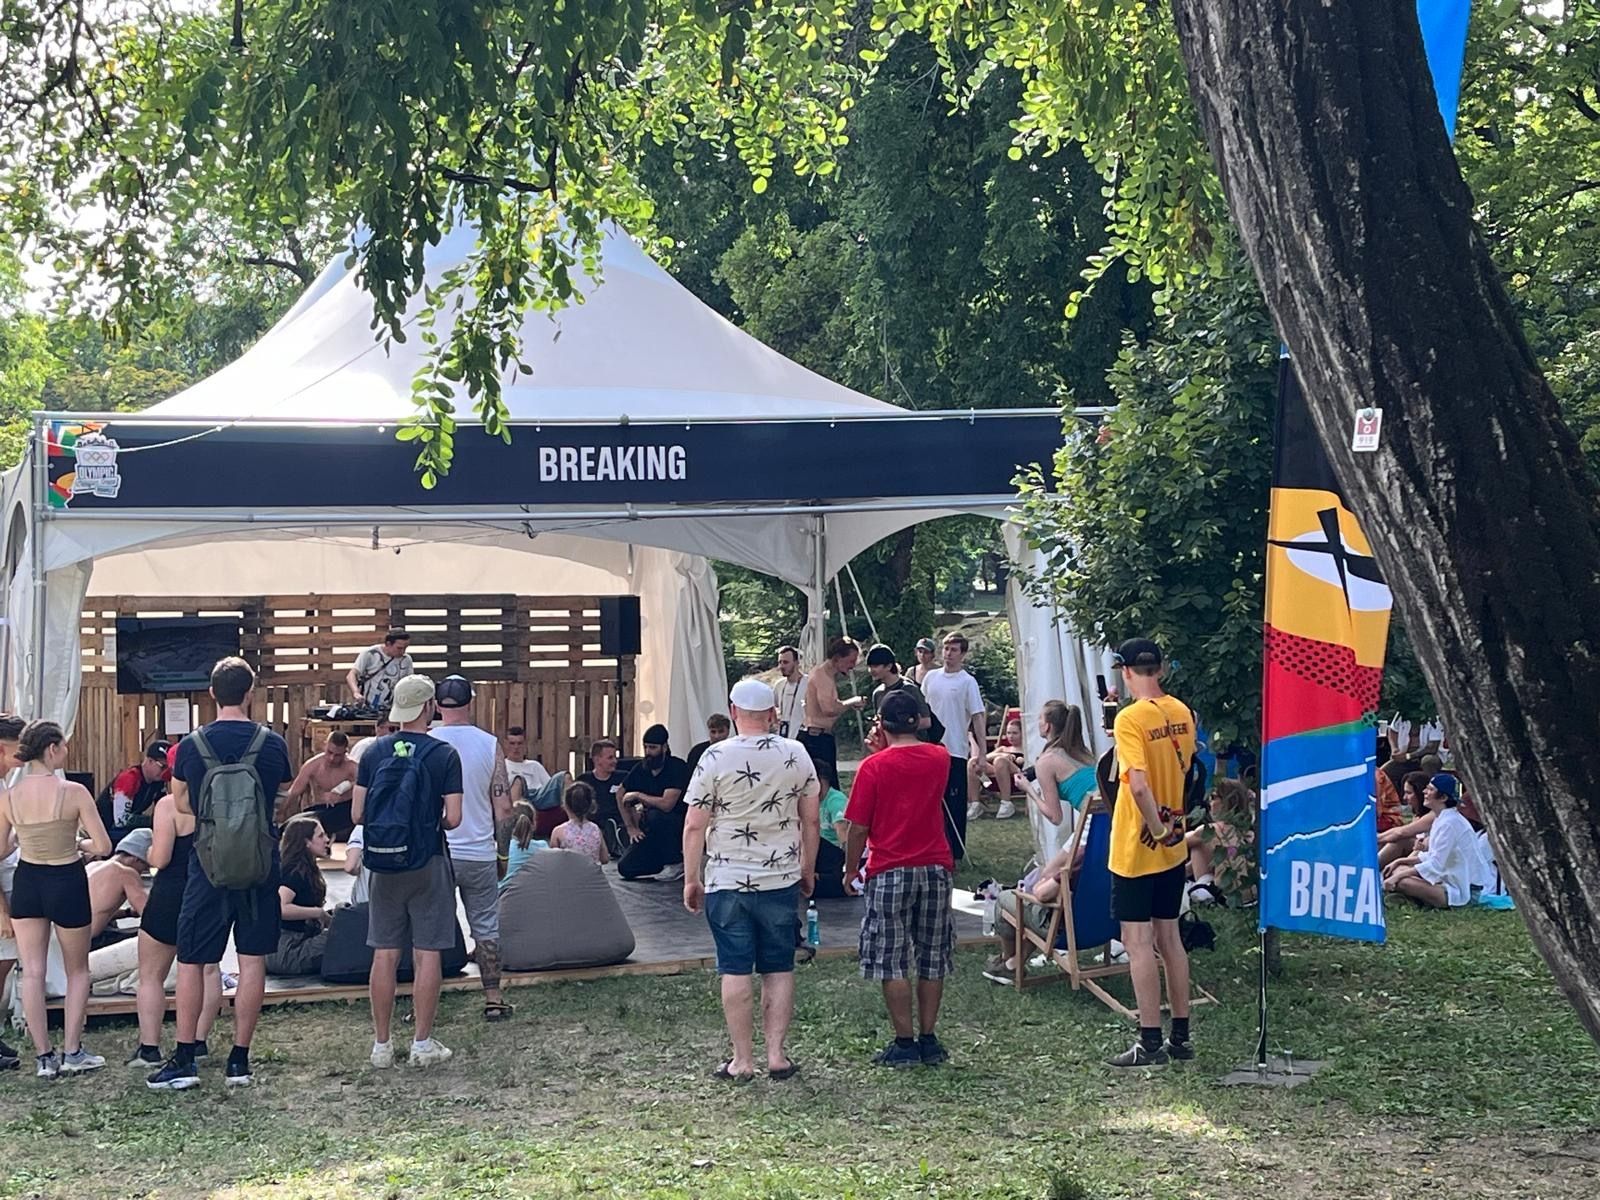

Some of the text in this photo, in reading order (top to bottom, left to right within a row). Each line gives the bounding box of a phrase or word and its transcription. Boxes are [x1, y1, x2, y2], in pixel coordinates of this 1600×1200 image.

[78, 466, 114, 480] OLYMPIC
[539, 446, 686, 482] BREAKING
[1149, 723, 1188, 741] VOLUTEER
